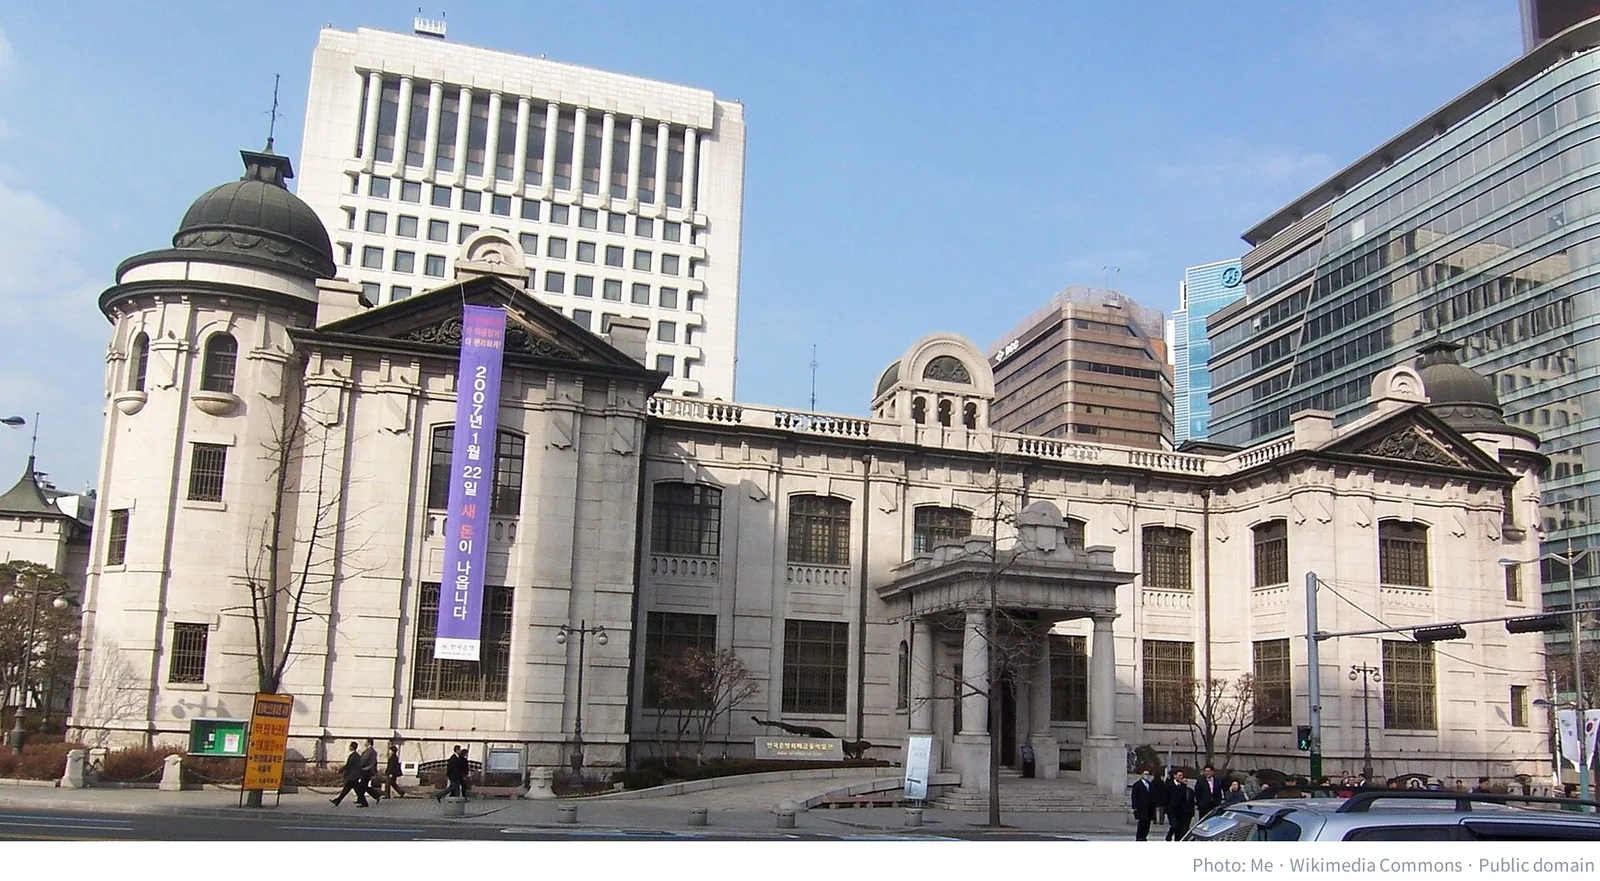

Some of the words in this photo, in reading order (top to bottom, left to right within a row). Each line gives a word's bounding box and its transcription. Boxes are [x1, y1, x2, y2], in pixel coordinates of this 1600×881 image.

[470, 366, 486, 428] 2007년
[467, 432, 480, 460] 1월
[463, 466, 482, 496] 22일
[461, 504, 476, 519] 새
[459, 524, 474, 555] 돈이
[453, 560, 471, 621] 나옵니다
